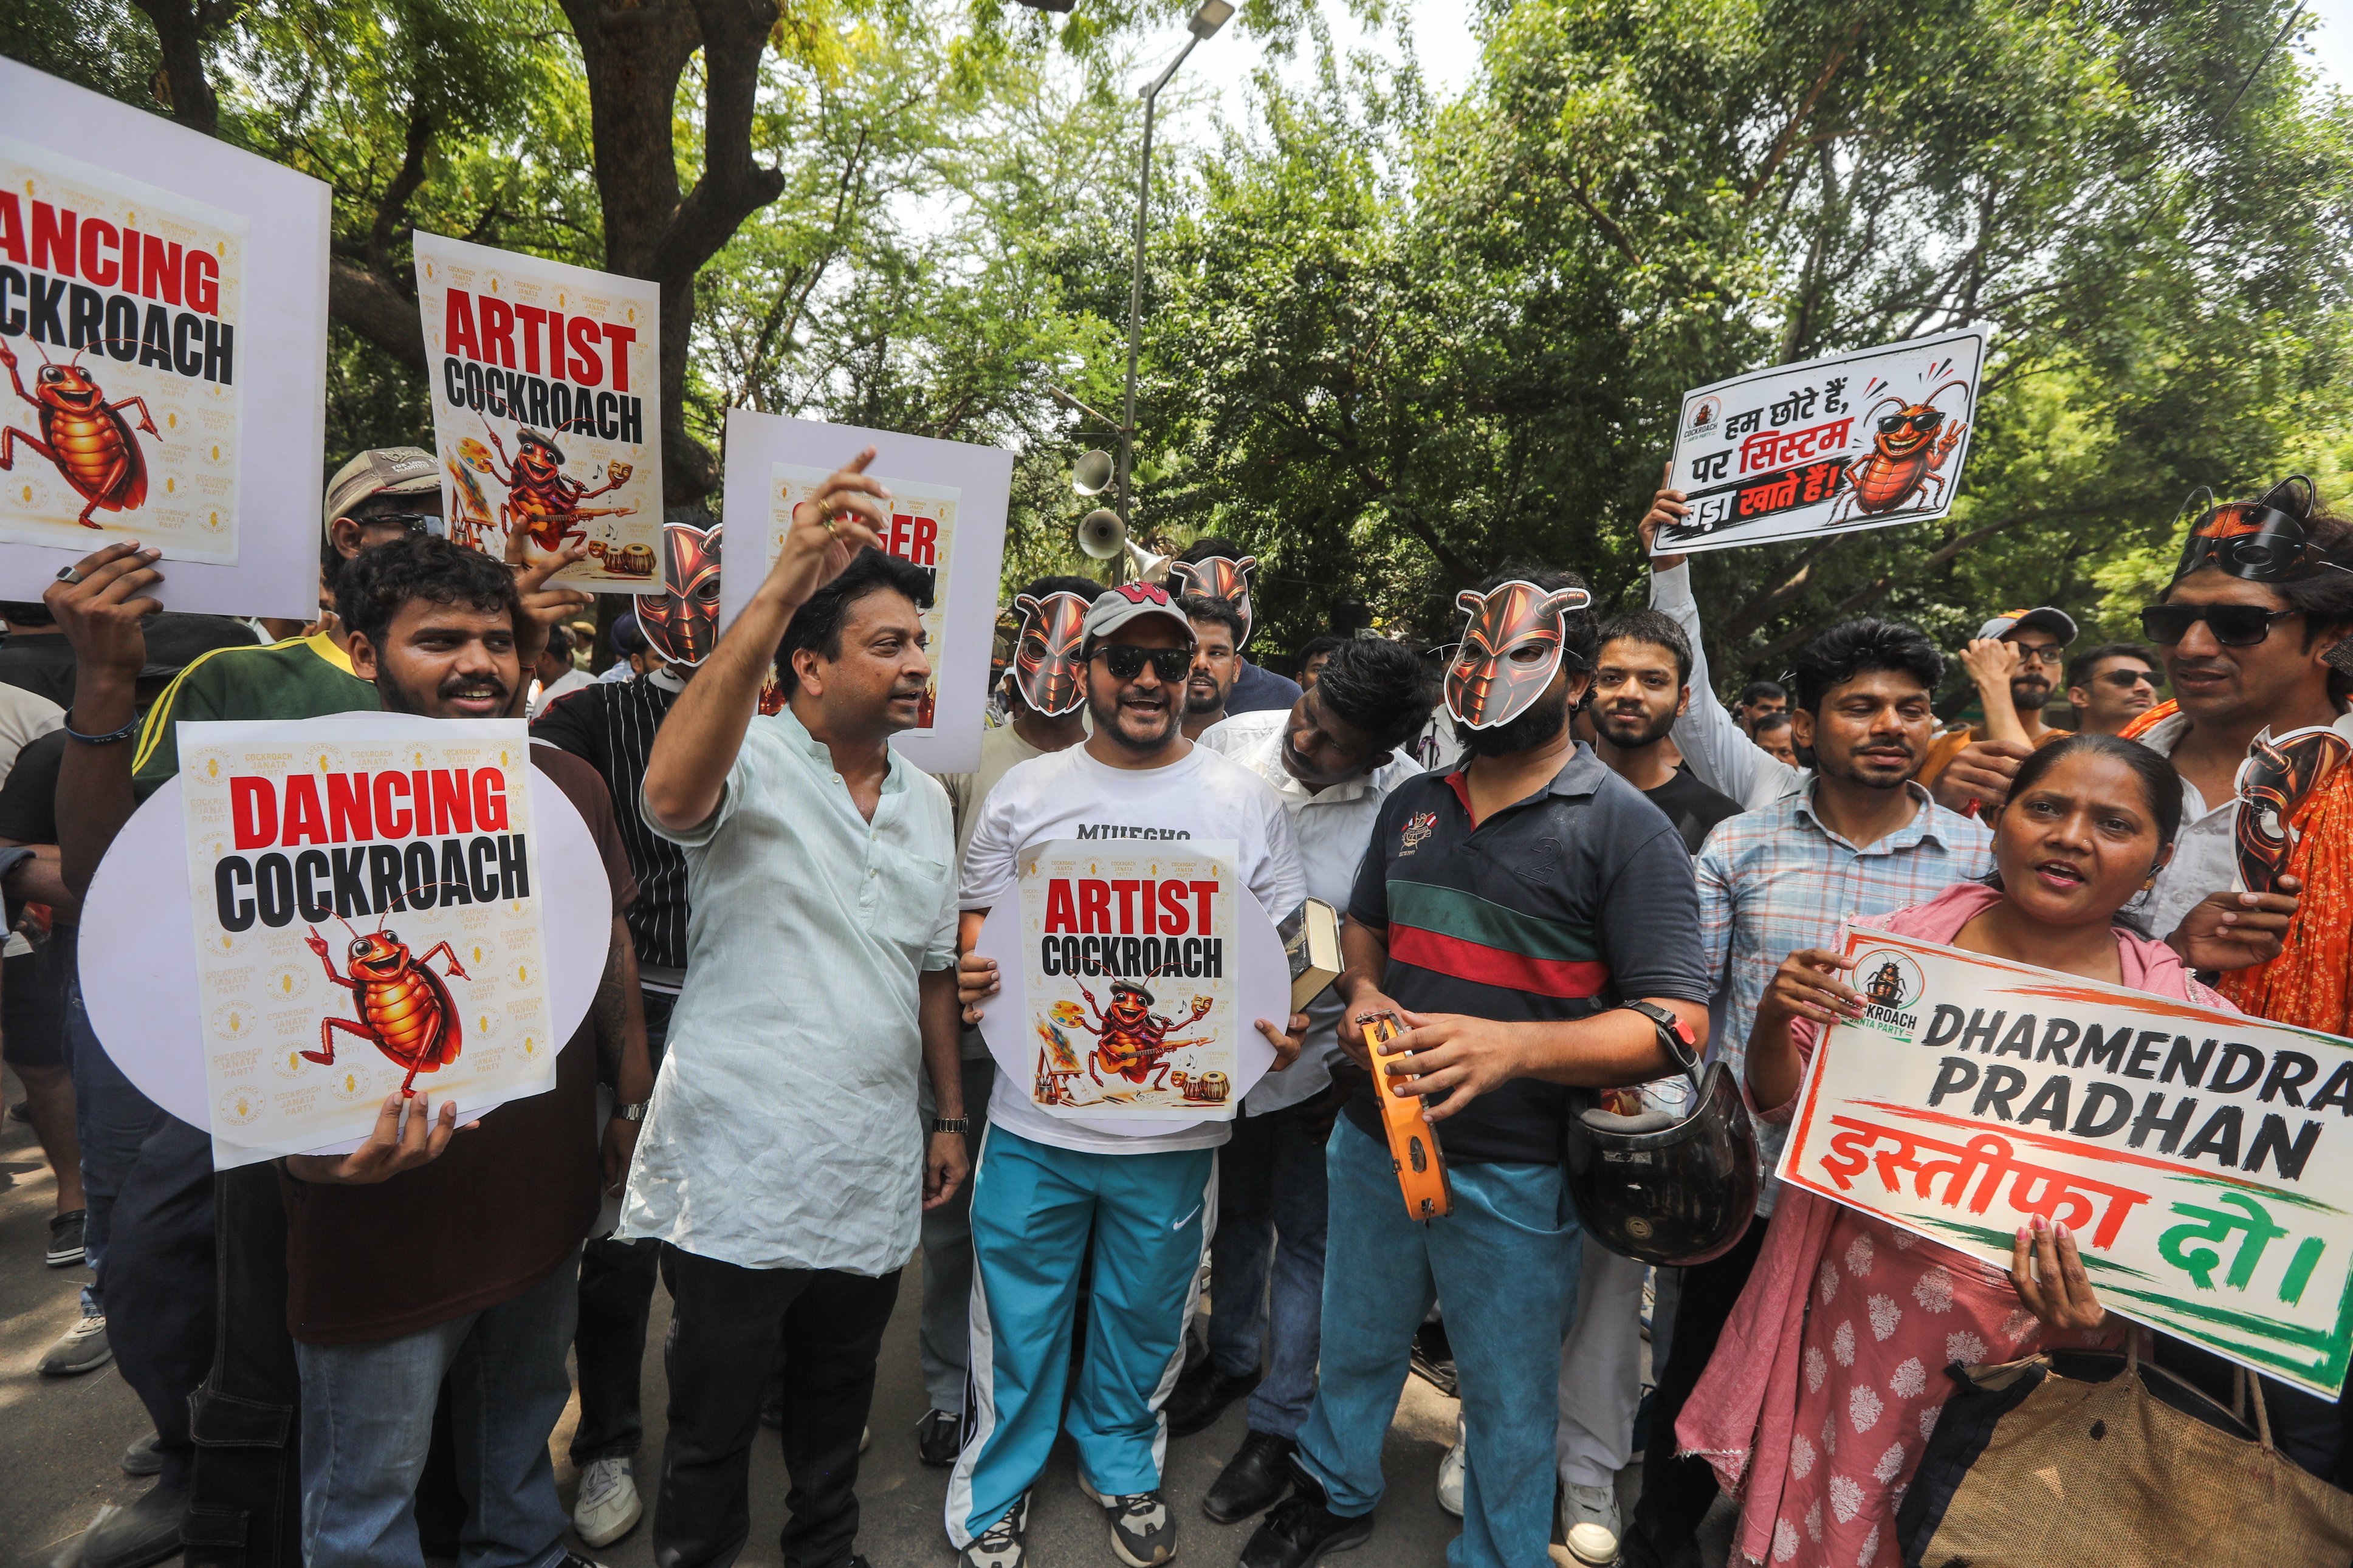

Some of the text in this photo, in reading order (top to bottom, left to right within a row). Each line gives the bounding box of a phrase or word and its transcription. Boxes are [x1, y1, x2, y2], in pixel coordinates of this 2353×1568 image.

[0, 188, 219, 317] ANCING
[447, 265, 475, 276] COCKROACH
[452, 274, 472, 282] JANATA
[454, 279, 471, 289] PARTY
[514, 281, 542, 292] COCKROACH
[517, 289, 539, 298] JANATA
[520, 295, 537, 304] PARTY
[581, 295, 611, 307] COCKROACH
[584, 303, 606, 312] JANATA
[587, 310, 605, 319] PARTY
[0, 264, 234, 385] CKROACH
[445, 287, 636, 392] ARTIST
[444, 357, 642, 445] COCKROACH
[1725, 376, 1849, 440] हम छोटे हैं,
[1684, 422, 1719, 438] COCKROACH
[1692, 416, 1855, 484] पर सिस्टम
[1739, 470, 1801, 516] खाते
[1802, 463, 1840, 502] हैं!
[1115, 581, 1169, 606] W
[245, 753, 292, 761] COCKROACH
[251, 761, 287, 770] JANATA
[230, 767, 509, 851] DANCING
[215, 834, 530, 933] COCKROACH
[456, 907, 493, 917] COCKROACH
[1044, 879, 1219, 936] ARTIST
[461, 914, 489, 924] JANATA
[464, 923, 487, 931] PARTY
[500, 926, 537, 938] COCKROACH
[266, 937, 303, 950] JANATA
[505, 935, 532, 945] JANATA
[271, 946, 300, 957] PARTY
[509, 943, 531, 951] PARTY
[1041, 935, 1222, 978] COCKROACH
[506, 996, 543, 1008] COCKROACH
[267, 1007, 314, 1021] COCKROACH
[511, 1005, 538, 1015] JANATA
[1853, 1002, 1918, 1030] KROACH
[273, 1016, 309, 1029] JANATA
[515, 1013, 537, 1022] PARTY
[278, 1025, 306, 1036] PARTY
[1877, 1022, 1905, 1037] PARTY
[469, 1046, 506, 1060] COCKROACH
[473, 1055, 502, 1067] JANATA
[1920, 1003, 2353, 1117] DHARMENDRA
[476, 1064, 500, 1073] PARTY
[275, 1085, 321, 1101] COCKROACH
[281, 1095, 316, 1109] JANATA
[285, 1104, 314, 1117] PARTY
[1926, 1055, 2326, 1182] PRADHAN
[1819, 1114, 2154, 1251] इस्तीफा
